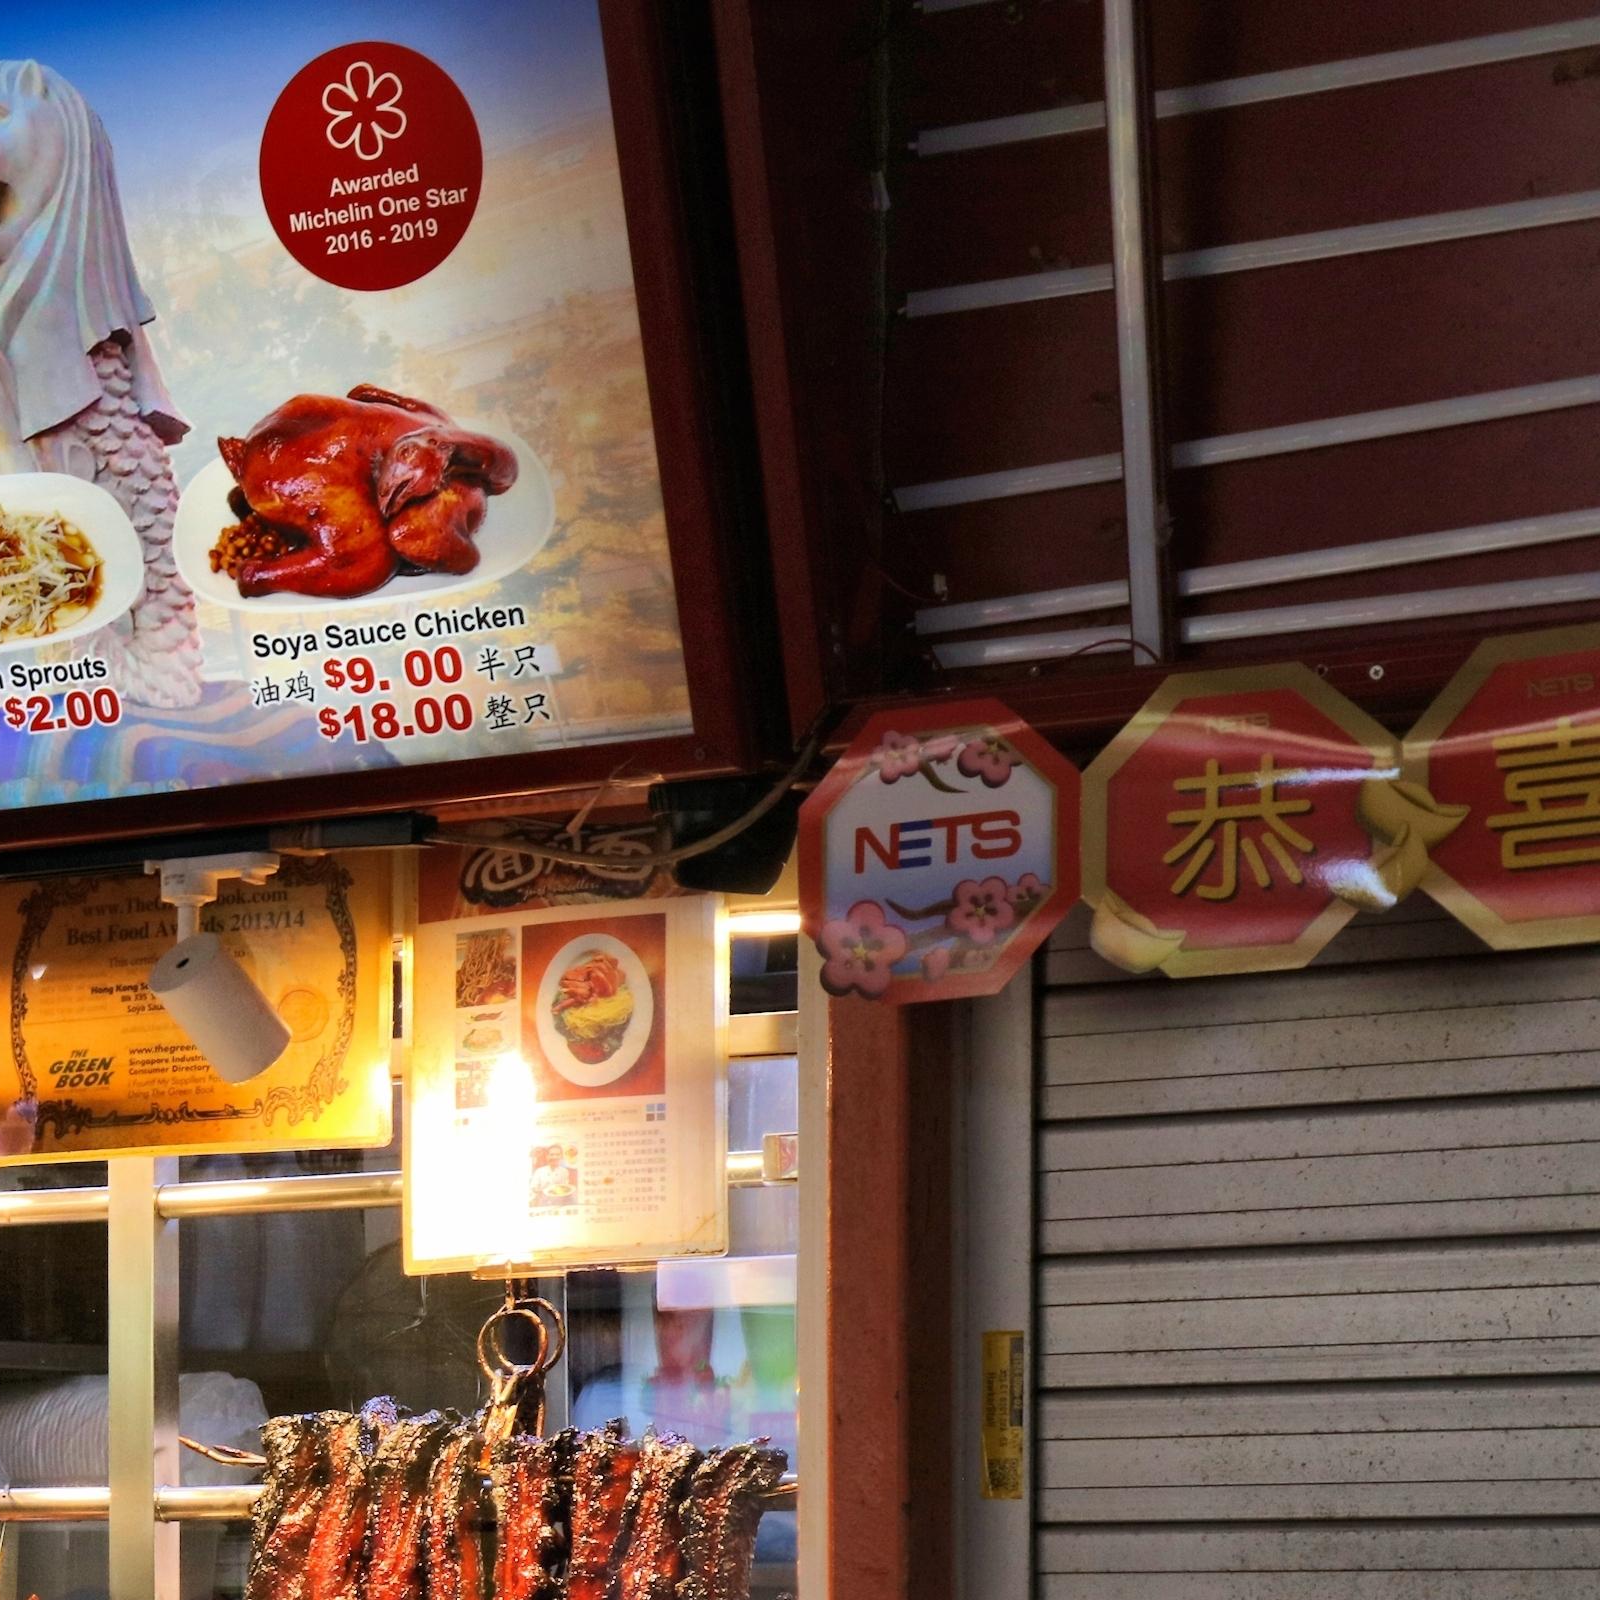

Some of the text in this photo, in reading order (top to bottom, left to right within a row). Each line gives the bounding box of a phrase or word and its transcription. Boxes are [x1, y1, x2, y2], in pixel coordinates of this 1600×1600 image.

[330, 163, 419, 197] Awarded
[289, 187, 468, 233] Michelin One Star
[325, 229, 373, 255] 2016
[391, 218, 438, 244] 2019
[251, 602, 526, 661] Soya Sauce Chicken
[9, 656, 107, 692] Sprouts
[252, 670, 316, 708] 油鸡
[476, 644, 542, 682] 半只
[4, 686, 121, 733] $2.00
[319, 692, 551, 745] $18.00 整只
[1163, 715, 1600, 902] 恭 喜
[853, 808, 1022, 876] NETS
[68, 910, 305, 946] Best Food 2013/14
[49, 1057, 113, 1075] GREEN
[70, 1050, 89, 1059] THE
[55, 1071, 112, 1089] BOOK
